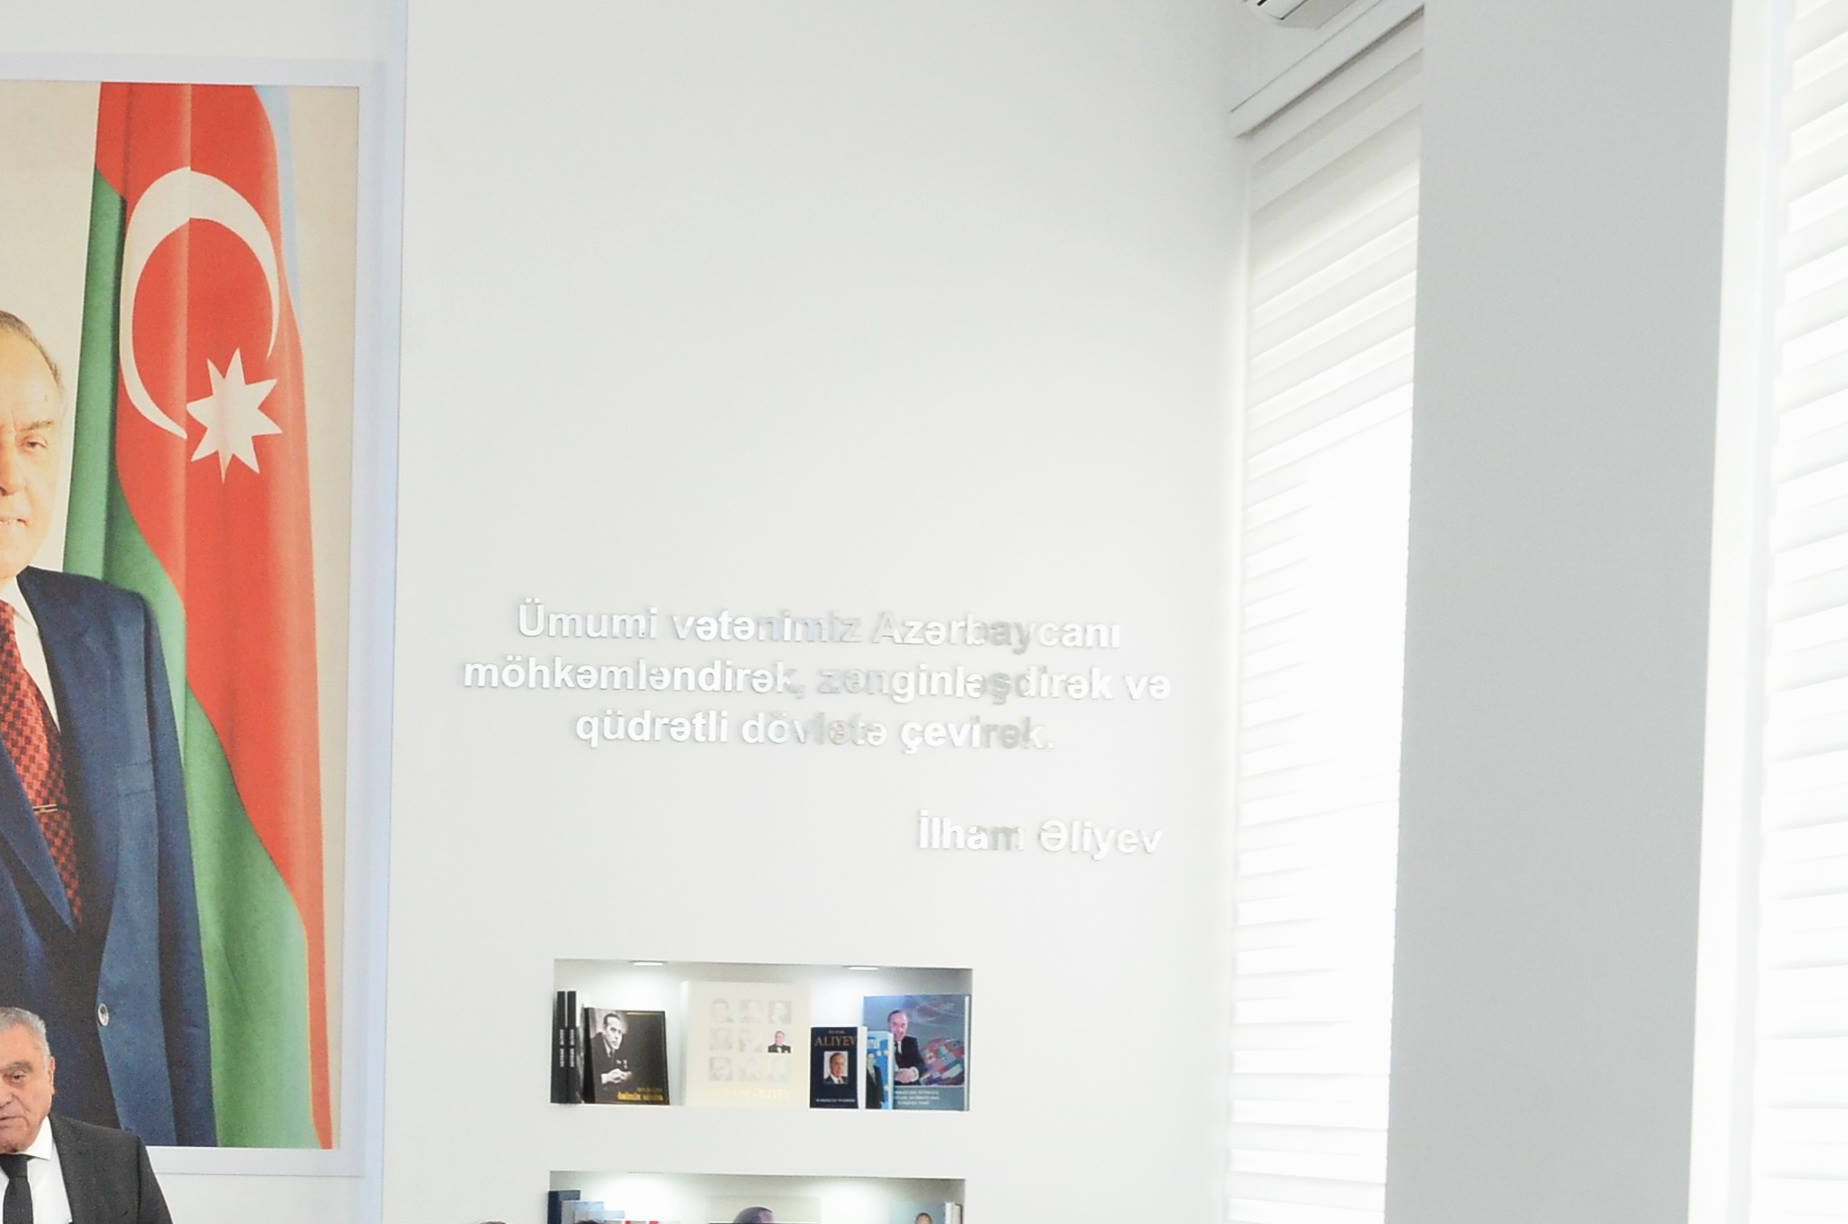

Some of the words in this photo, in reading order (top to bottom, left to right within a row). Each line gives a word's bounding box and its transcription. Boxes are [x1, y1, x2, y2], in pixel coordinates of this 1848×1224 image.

[517, 597, 658, 641] Ümumi
[672, 607, 864, 645] vətənimiz
[872, 610, 1122, 655] Azərbaycanı
[816, 663, 1113, 706] zənginləşdirək
[1125, 672, 1172, 701] və
[574, 709, 729, 749] qüdrətli
[742, 714, 887, 748] dövlətə
[902, 718, 1055, 757] çevirək.
[916, 809, 1025, 851] İlham
[1038, 815, 1162, 861] Əliyev
